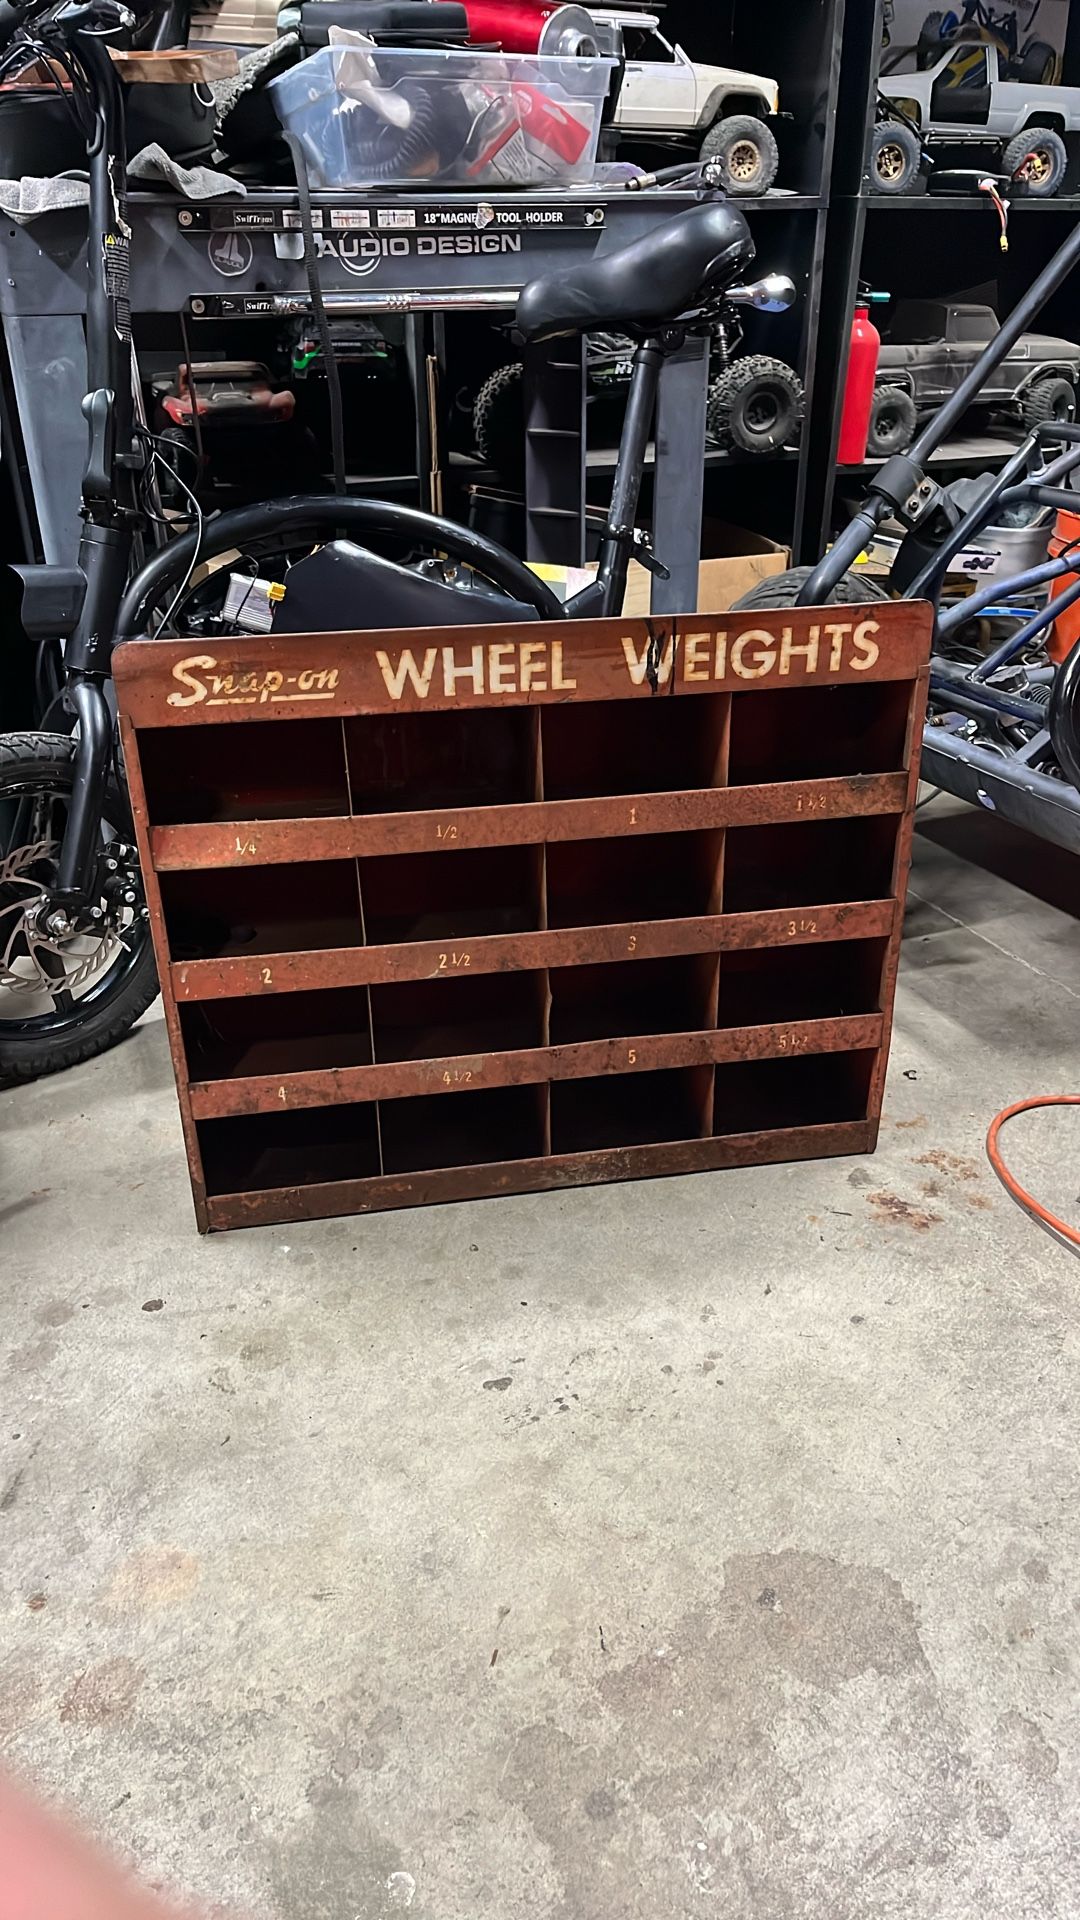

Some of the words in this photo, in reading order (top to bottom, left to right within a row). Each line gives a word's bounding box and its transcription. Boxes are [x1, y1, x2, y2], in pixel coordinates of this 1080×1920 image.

[495, 212, 522, 224] TOOL
[525, 211, 564, 223] HOLDER
[316, 237, 410, 258] AUDIO
[416, 233, 522, 255] DESIGN
[166, 654, 340, 707] Snap-on
[375, 640, 578, 700] WHEEL
[620, 619, 882, 686] WEIGHTS
[629, 807, 638, 825] 1
[436, 824, 458, 840] 1/2
[235, 836, 257, 856] 1/4
[627, 935, 637, 951] 3
[261, 967, 273, 984] 2
[628, 1049, 637, 1065] 5
[278, 1085, 288, 1102] 4
